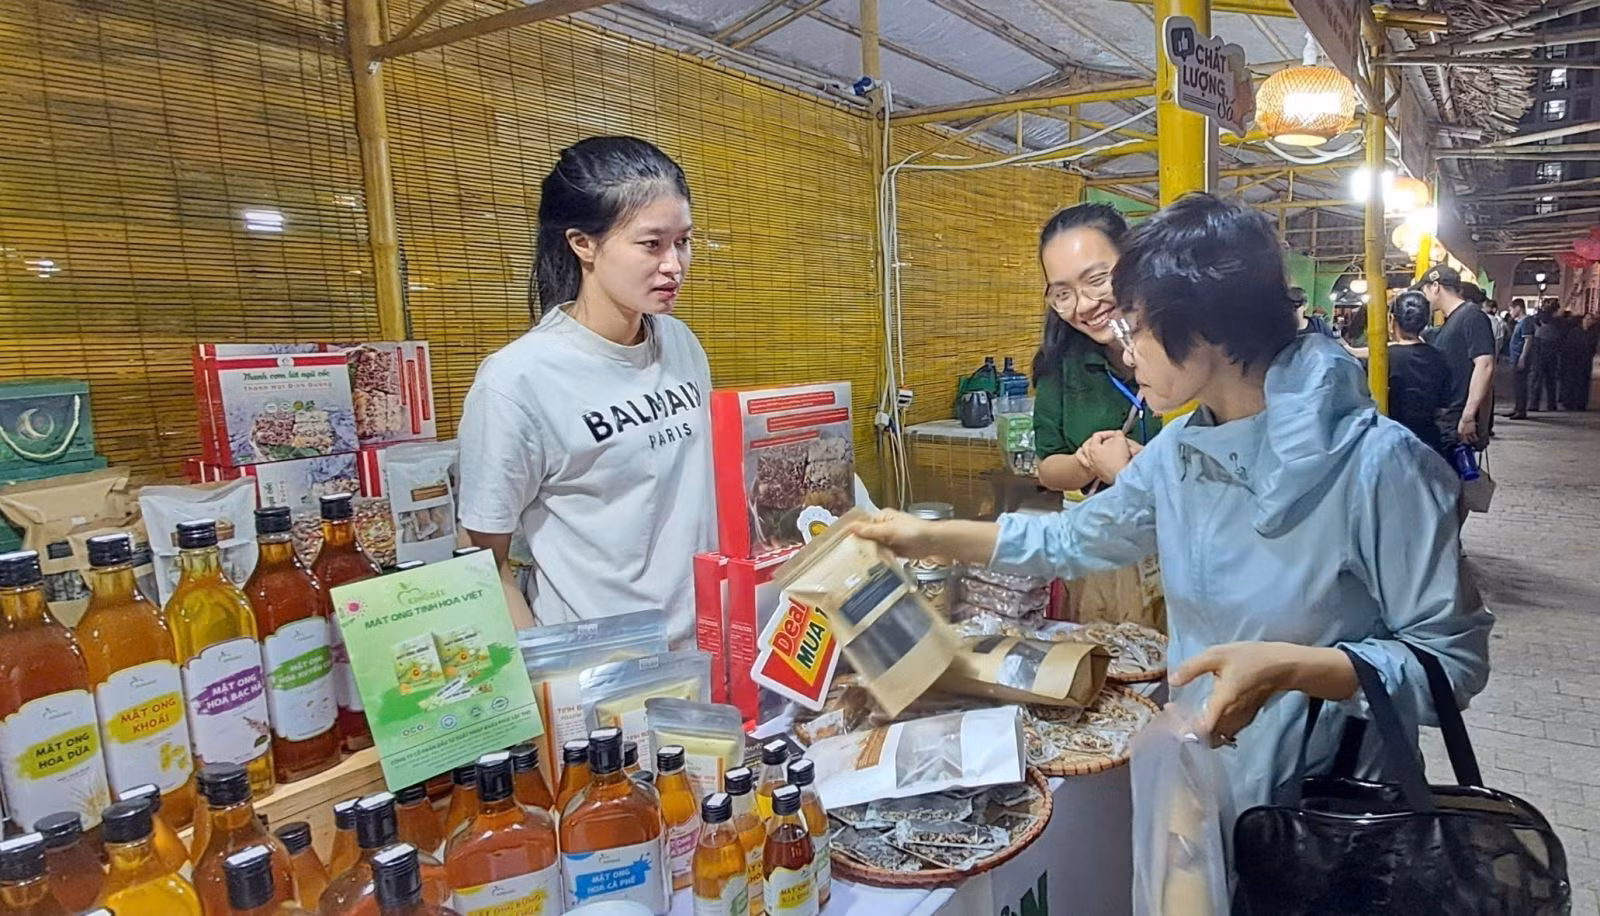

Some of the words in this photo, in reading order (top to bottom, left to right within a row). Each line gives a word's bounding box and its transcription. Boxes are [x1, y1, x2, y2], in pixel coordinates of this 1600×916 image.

[1195, 44, 1227, 74] CHẤT
[1182, 64, 1226, 98] LƯỢNG
[581, 380, 702, 443] BALMAIN
[648, 422, 692, 449] PARIS
[391, 609, 414, 622] ONG
[415, 603, 438, 615] TINH
[439, 597, 461, 608] HOA
[772, 597, 808, 657] Deal
[796, 621, 826, 669] MUA
[237, 673, 257, 687] ONG
[151, 697, 176, 713] ONG
[206, 696, 229, 709] HOA
[133, 713, 170, 733] KHOÁI
[403, 720, 427, 736] OCO
[66, 732, 90, 747] ONG
[38, 755, 64, 769] HOA
